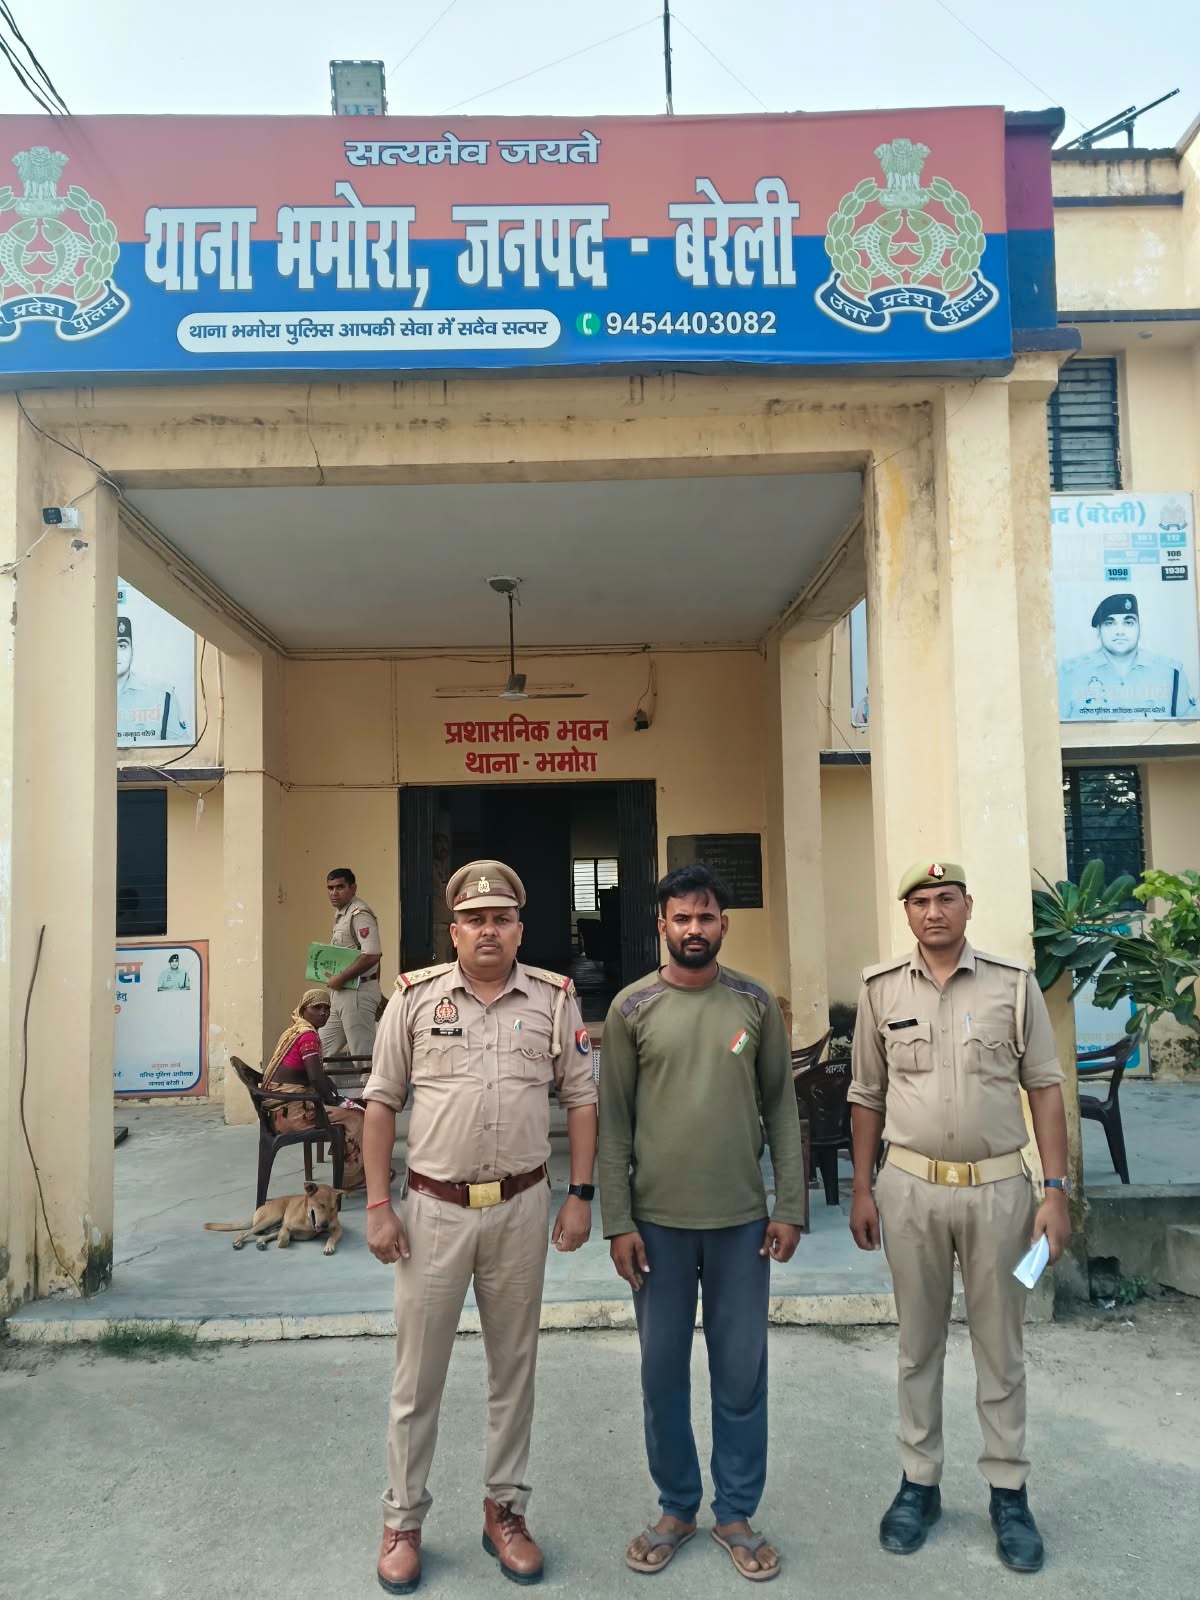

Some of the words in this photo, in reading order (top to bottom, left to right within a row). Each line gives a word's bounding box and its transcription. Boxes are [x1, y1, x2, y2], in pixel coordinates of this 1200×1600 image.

[344, 130, 490, 166] सत्यमेव
[497, 129, 602, 165] जयते
[143, 205, 259, 293] थाना
[451, 202, 610, 291] जनपद
[667, 176, 801, 288] बरेली
[11, 298, 65, 317] प्रदेश
[74, 296, 122, 334] पुलिस
[829, 293, 872, 324] उत्तर
[879, 288, 934, 309] प्रदेश
[942, 287, 989, 325] पुलिस
[188, 320, 227, 340] थाना
[232, 317, 282, 340] भमोरा
[286, 316, 335, 346] पुलिस
[338, 316, 396, 340] आपकी
[400, 316, 433, 338] सेवा
[437, 315, 457, 338] में
[458, 316, 498, 337] सदैव
[606, 311, 777, 336] 9454403082
[1107, 568, 1129, 577] 1098
[445, 713, 550, 744] प्रशासनिक
[556, 720, 609, 741] भवन
[465, 752, 520, 774] थाना
[535, 746, 598, 773] भमोरा
